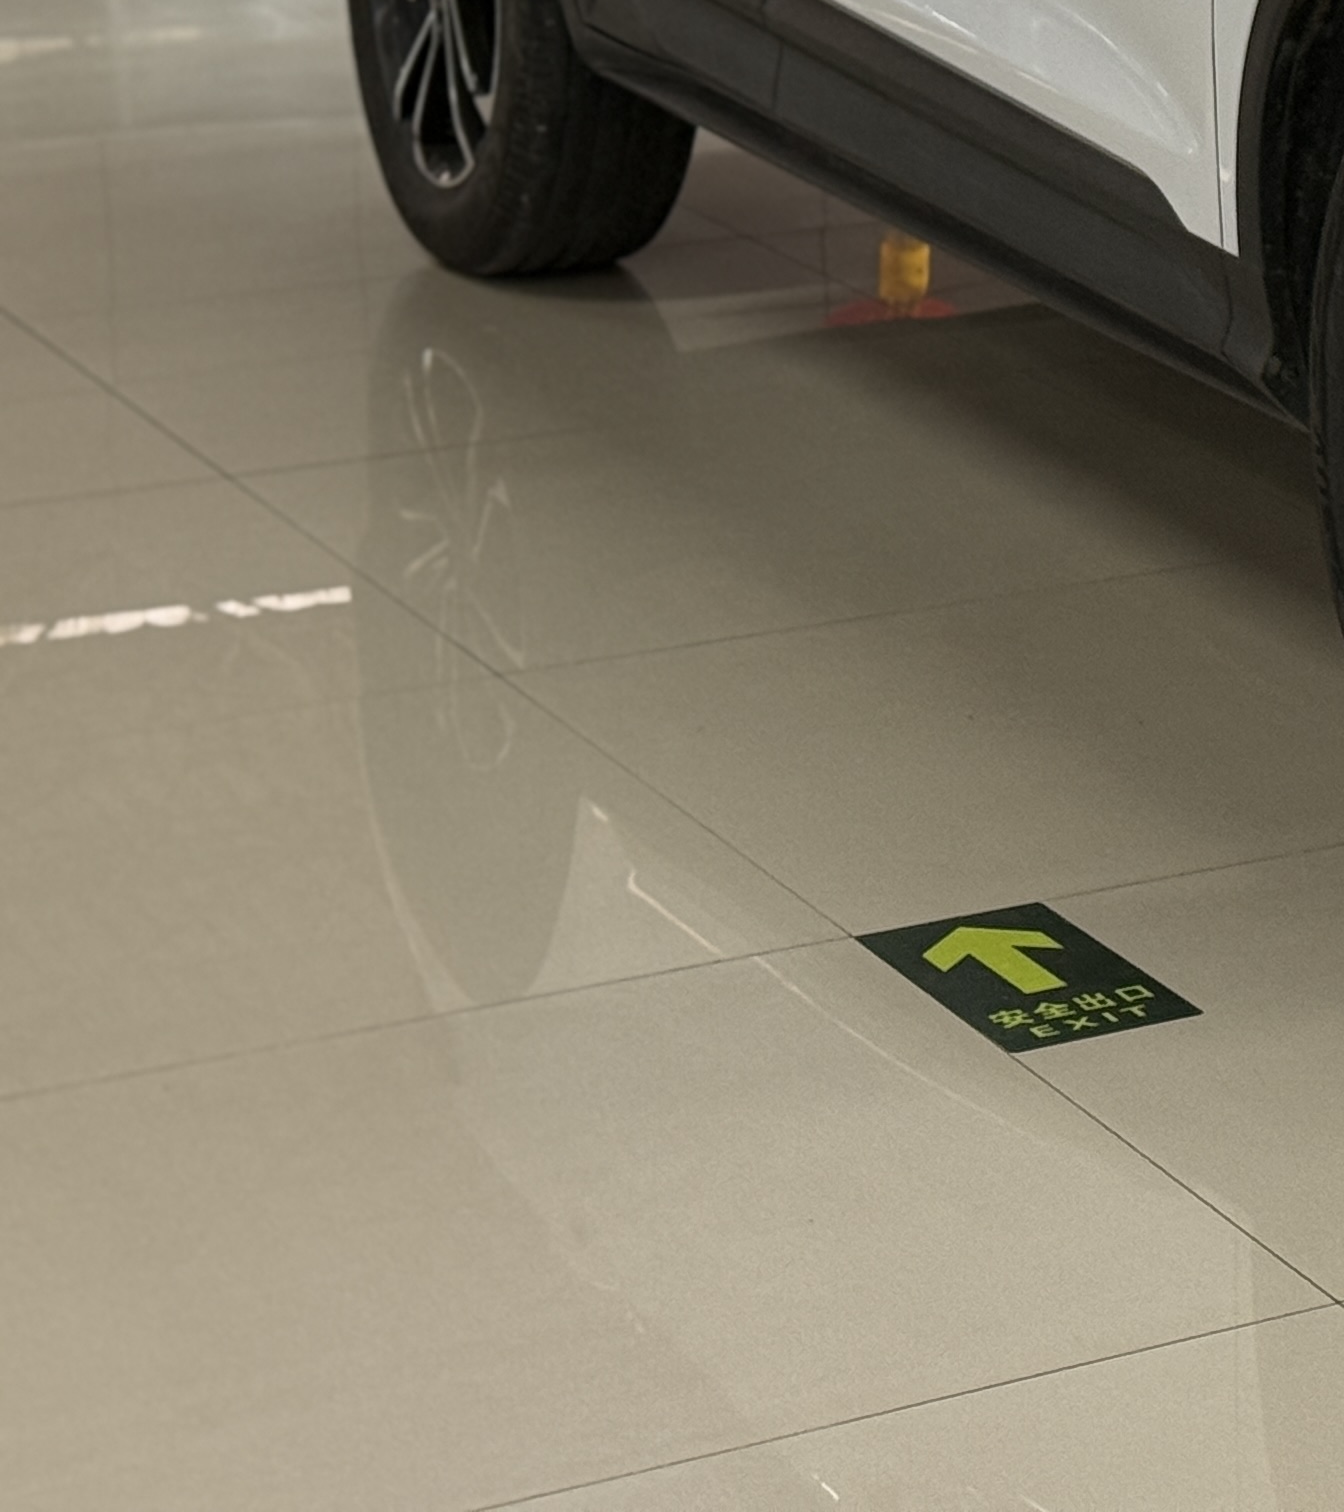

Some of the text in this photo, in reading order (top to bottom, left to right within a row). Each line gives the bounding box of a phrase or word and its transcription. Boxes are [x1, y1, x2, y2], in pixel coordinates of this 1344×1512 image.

[988, 984, 1155, 1030] 安全出口
[1029, 1004, 1149, 1039] EXIT
